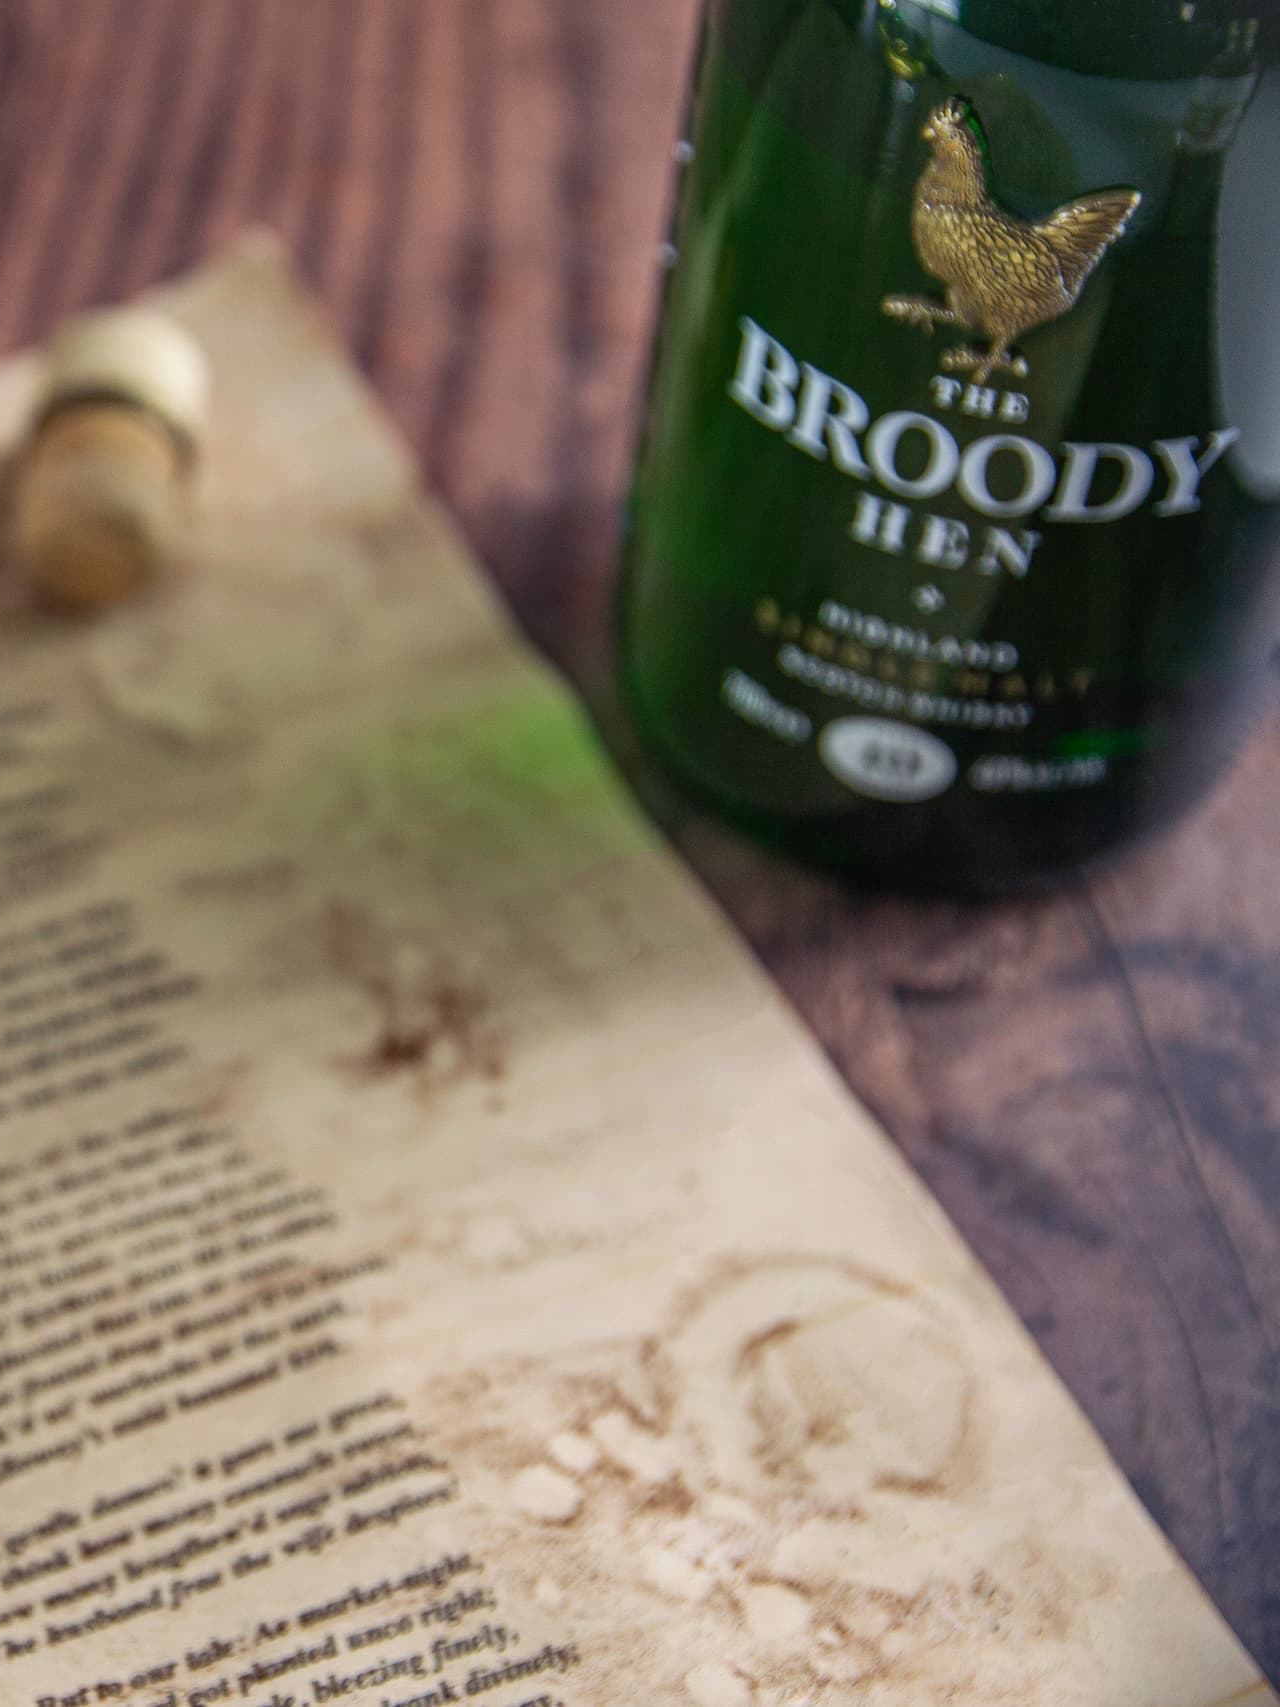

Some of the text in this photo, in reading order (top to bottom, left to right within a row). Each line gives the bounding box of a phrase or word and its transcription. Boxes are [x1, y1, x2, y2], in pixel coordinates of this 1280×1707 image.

[727, 316, 1240, 522] BROODY
[929, 376, 1031, 424] THE
[851, 493, 1043, 578] HEN
